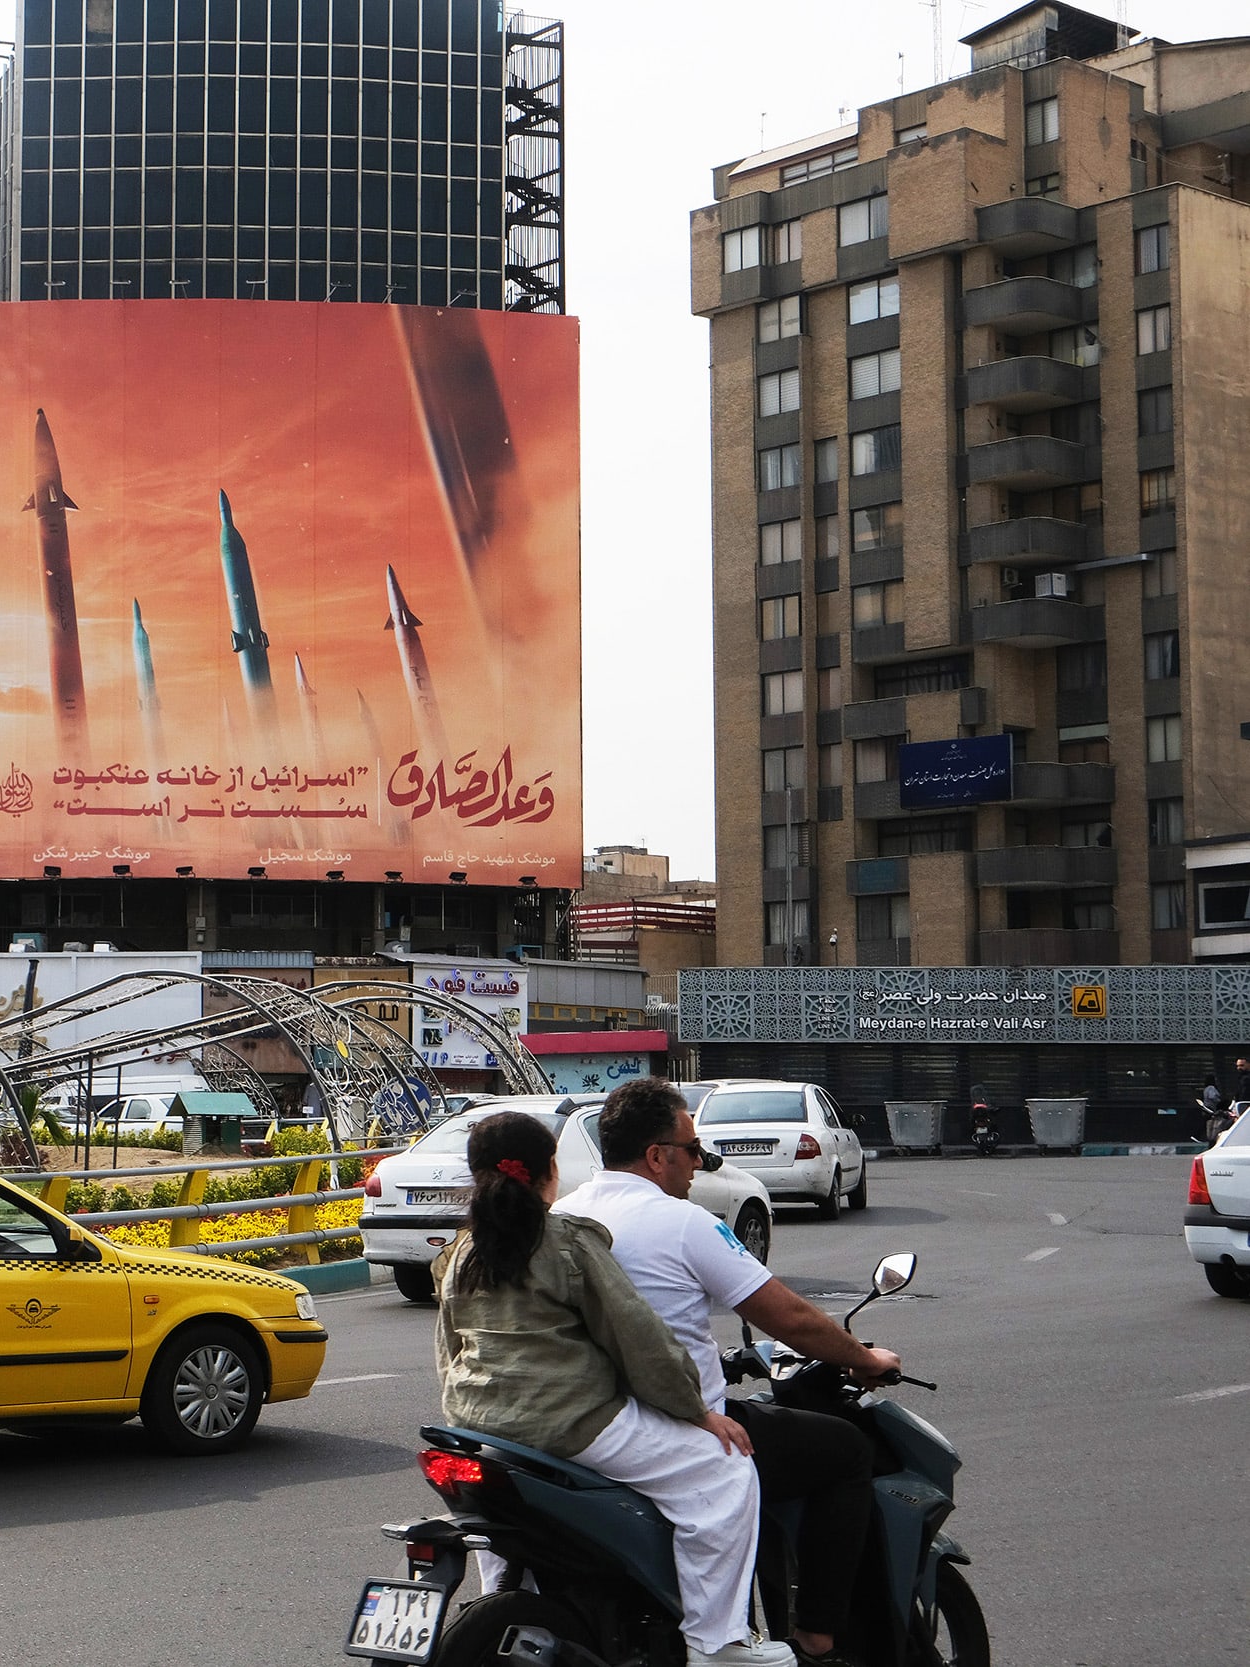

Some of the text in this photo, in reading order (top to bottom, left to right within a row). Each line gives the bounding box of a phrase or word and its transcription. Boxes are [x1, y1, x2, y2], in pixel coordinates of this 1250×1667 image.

[52, 763, 150, 791] عنکبوت
[155, 763, 221, 786] خانه
[224, 765, 244, 793] از
[176, 798, 225, 823] تر
[32, 846, 151, 863] موشک خیبر شکن
[259, 848, 352, 865] موشک سجیل
[422, 849, 556, 869] موشک شهید حاج قاسم
[468, 969, 520, 997] فست
[877, 989, 913, 1004] عصر
[916, 988, 942, 1005] ولی
[945, 988, 999, 1004] حضرت
[1002, 988, 1047, 1004] میدان
[858, 1016, 1047, 1031] Meydan-e Hazrat-e Vali Asr
[356, 1620, 431, 1651] ۵۱۸۵۶
